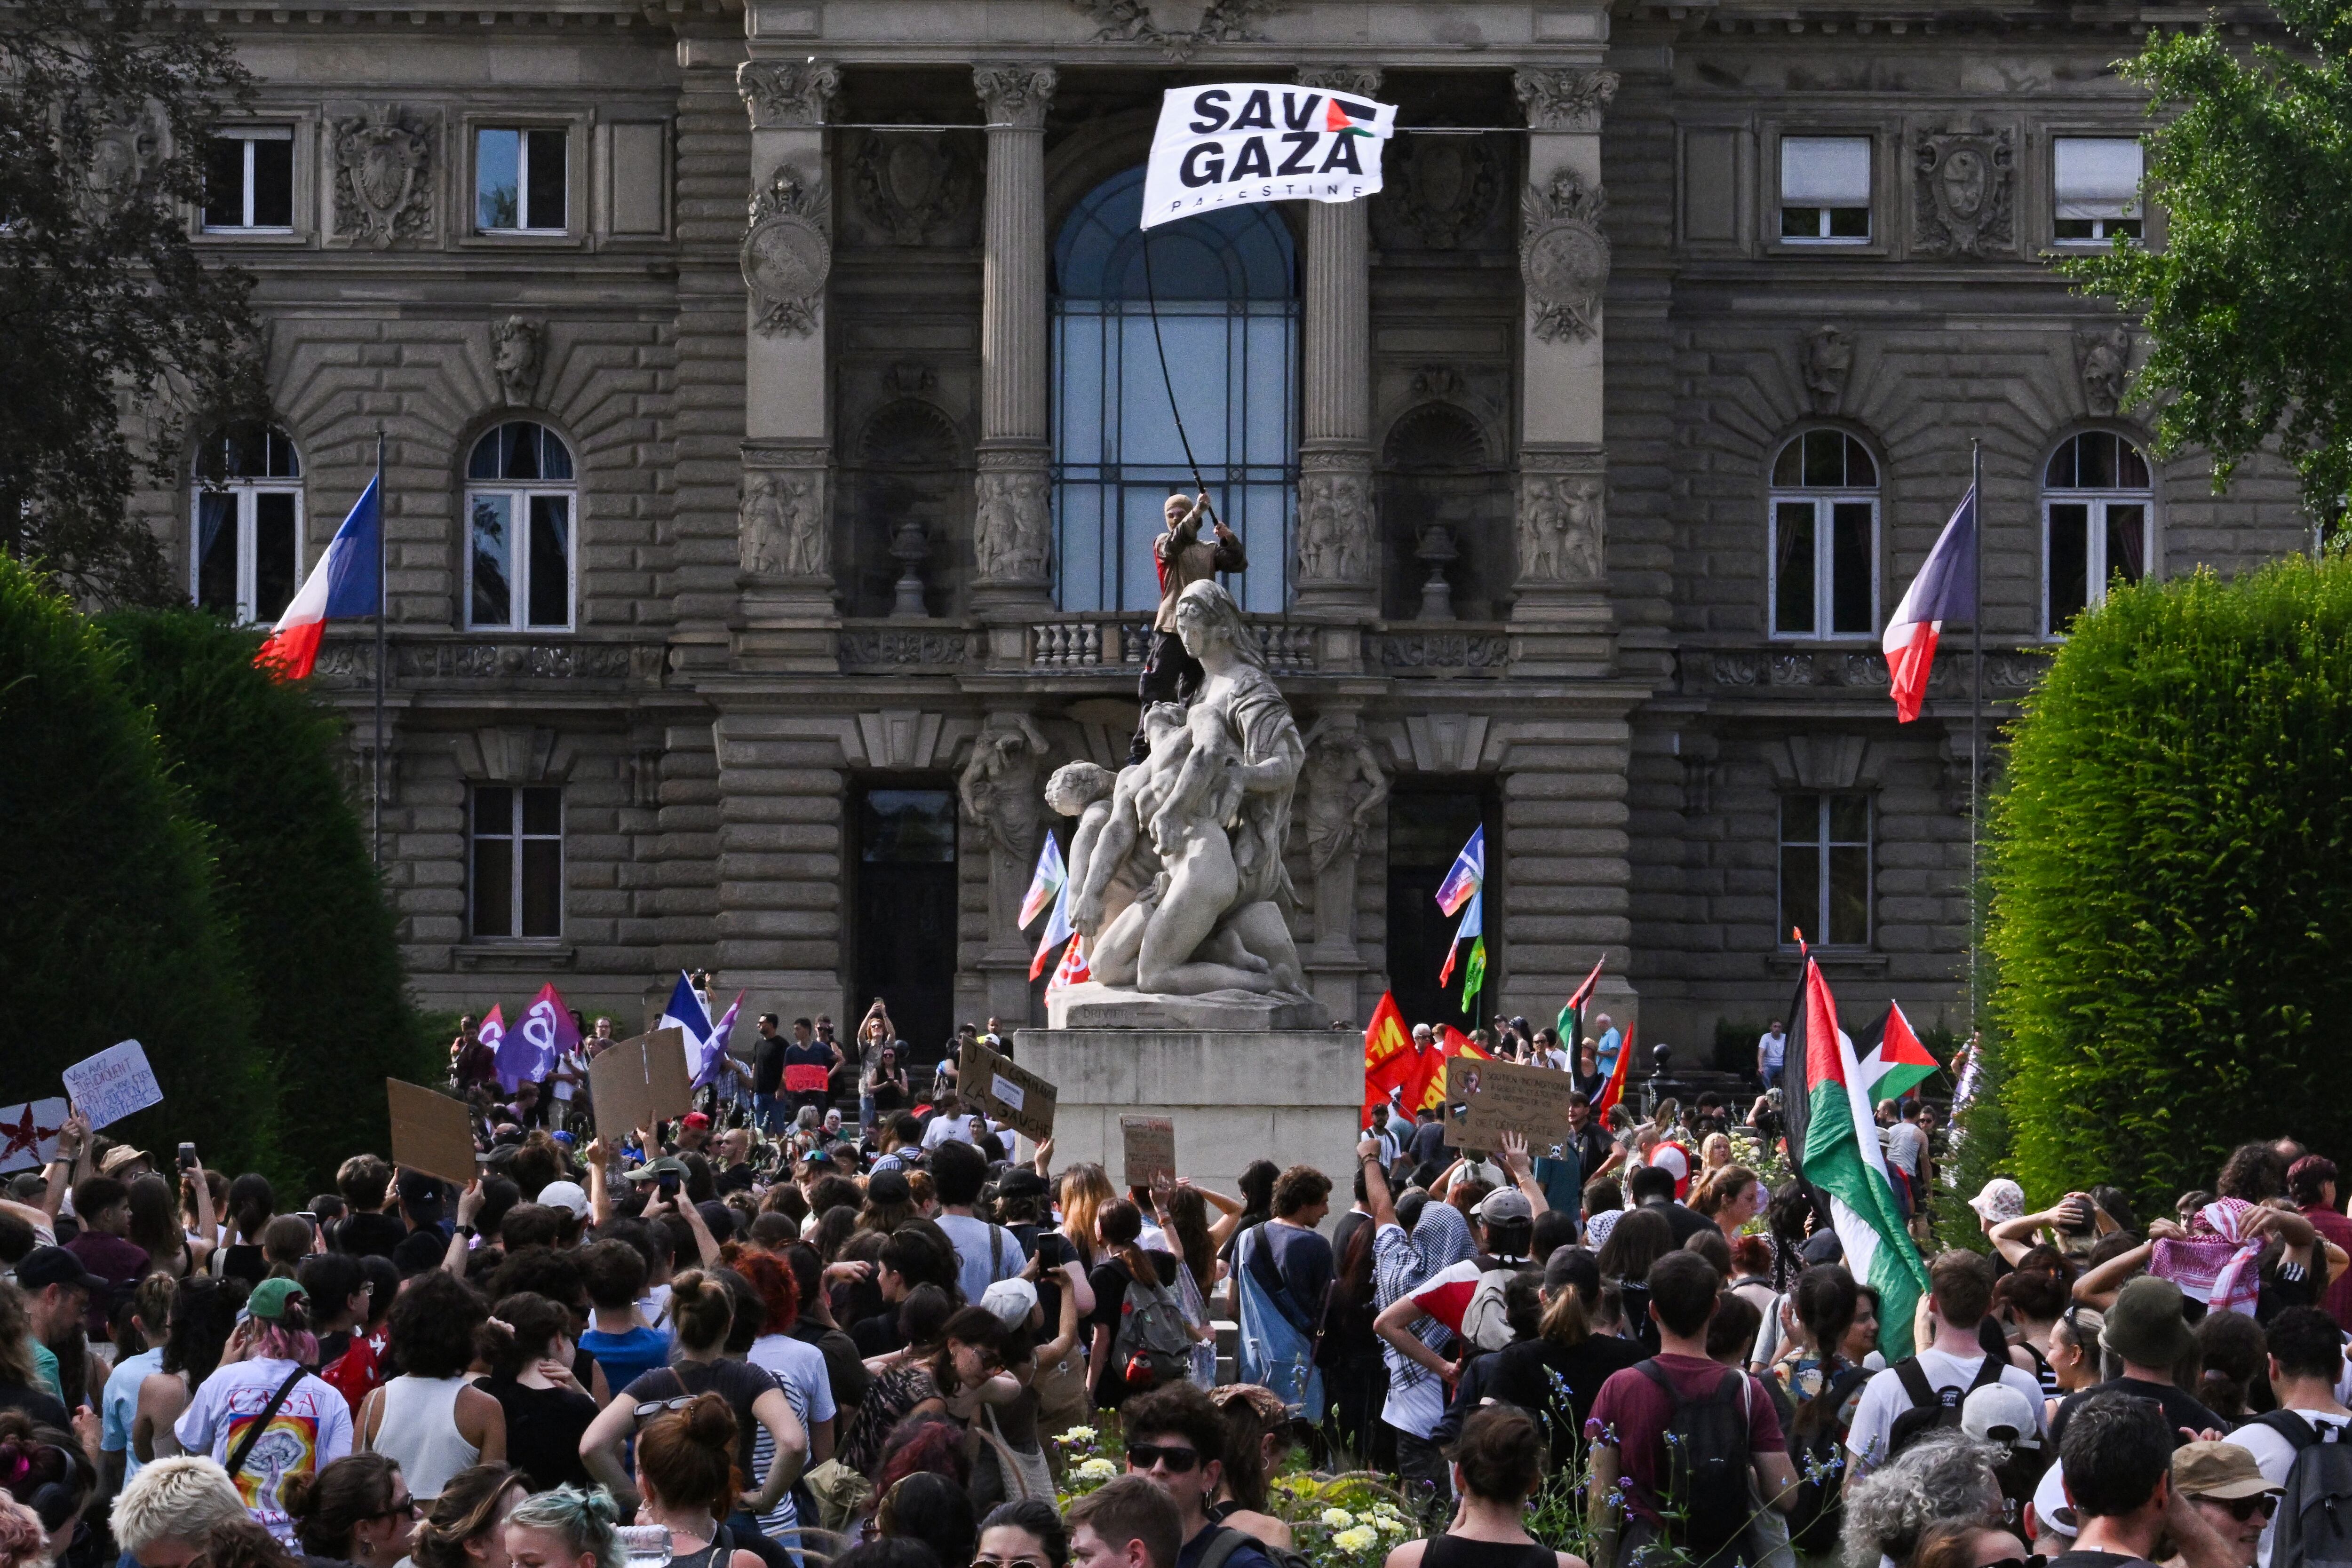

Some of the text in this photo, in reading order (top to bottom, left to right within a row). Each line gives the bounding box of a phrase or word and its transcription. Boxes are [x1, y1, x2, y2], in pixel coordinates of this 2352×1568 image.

[1180, 131, 1363, 188] GAZA
[90, 1087, 161, 1128] INORITAIRES
[964, 1081, 986, 1104] LA
[997, 1101, 1050, 1137] GAUCHE
[229, 1389, 318, 1416] CASA
